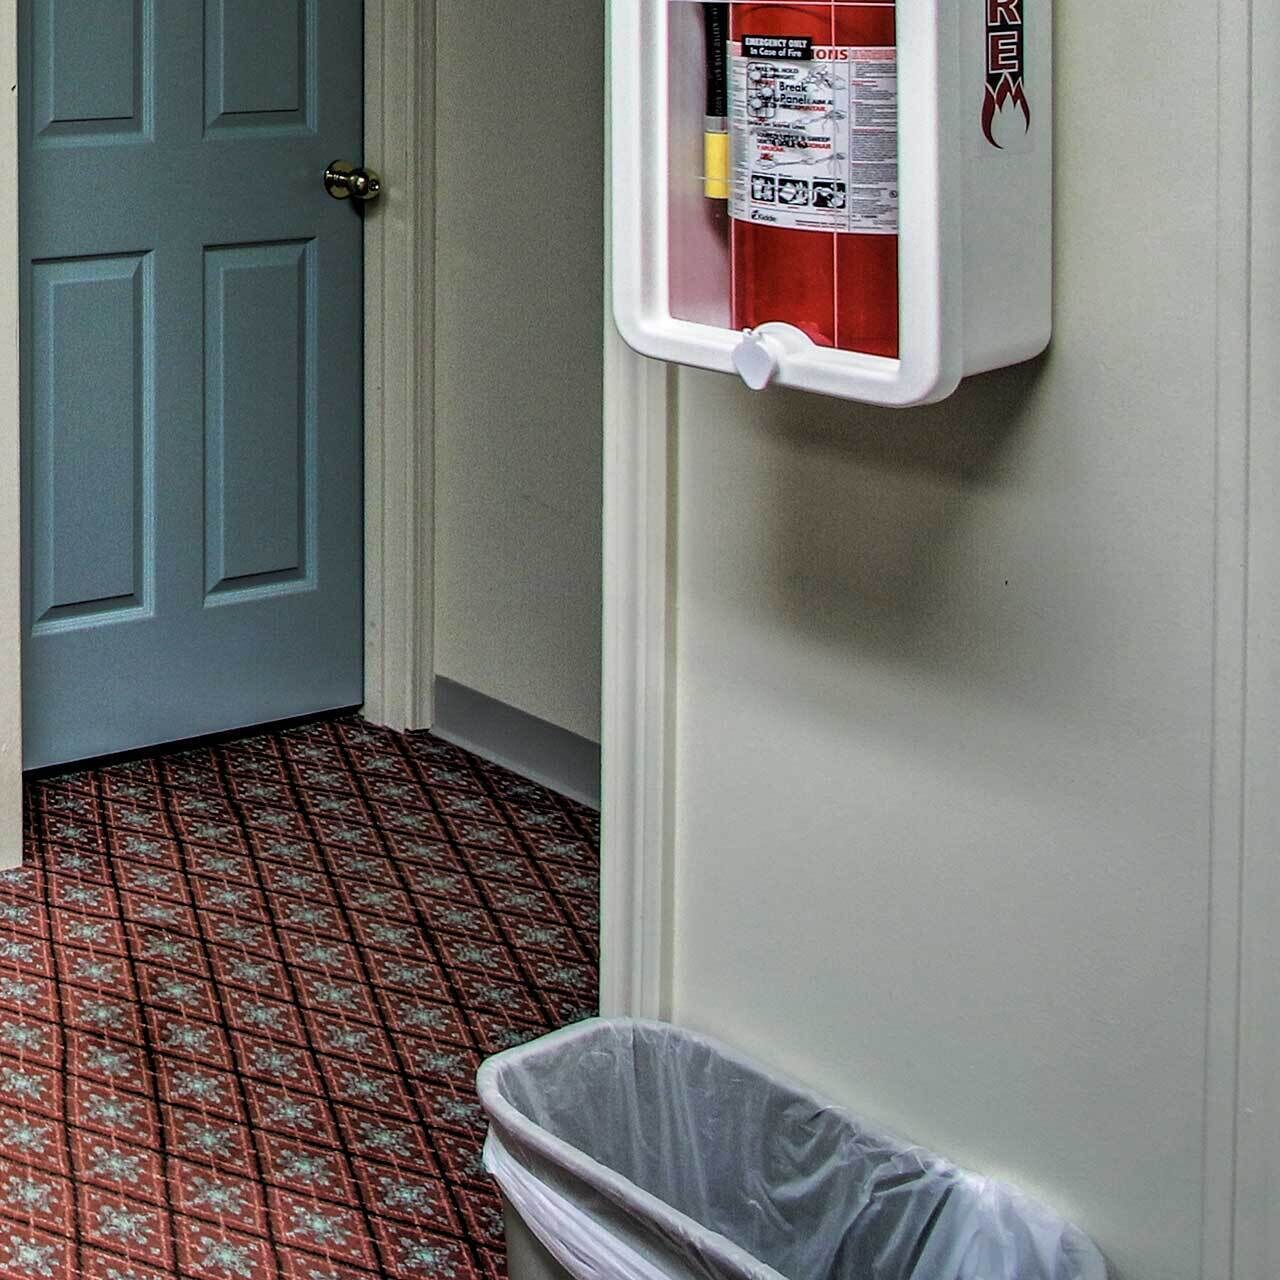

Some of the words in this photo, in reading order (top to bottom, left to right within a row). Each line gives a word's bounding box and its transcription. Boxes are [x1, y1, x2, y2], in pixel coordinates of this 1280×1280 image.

[745, 37, 786, 47] EMERGENCY
[788, 39, 808, 48] ONLY
[759, 47, 777, 56] Case
[778, 48, 786, 56] of
[788, 48, 802, 57] Fire
[779, 82, 808, 92] Break
[780, 94, 807, 105] Panel
